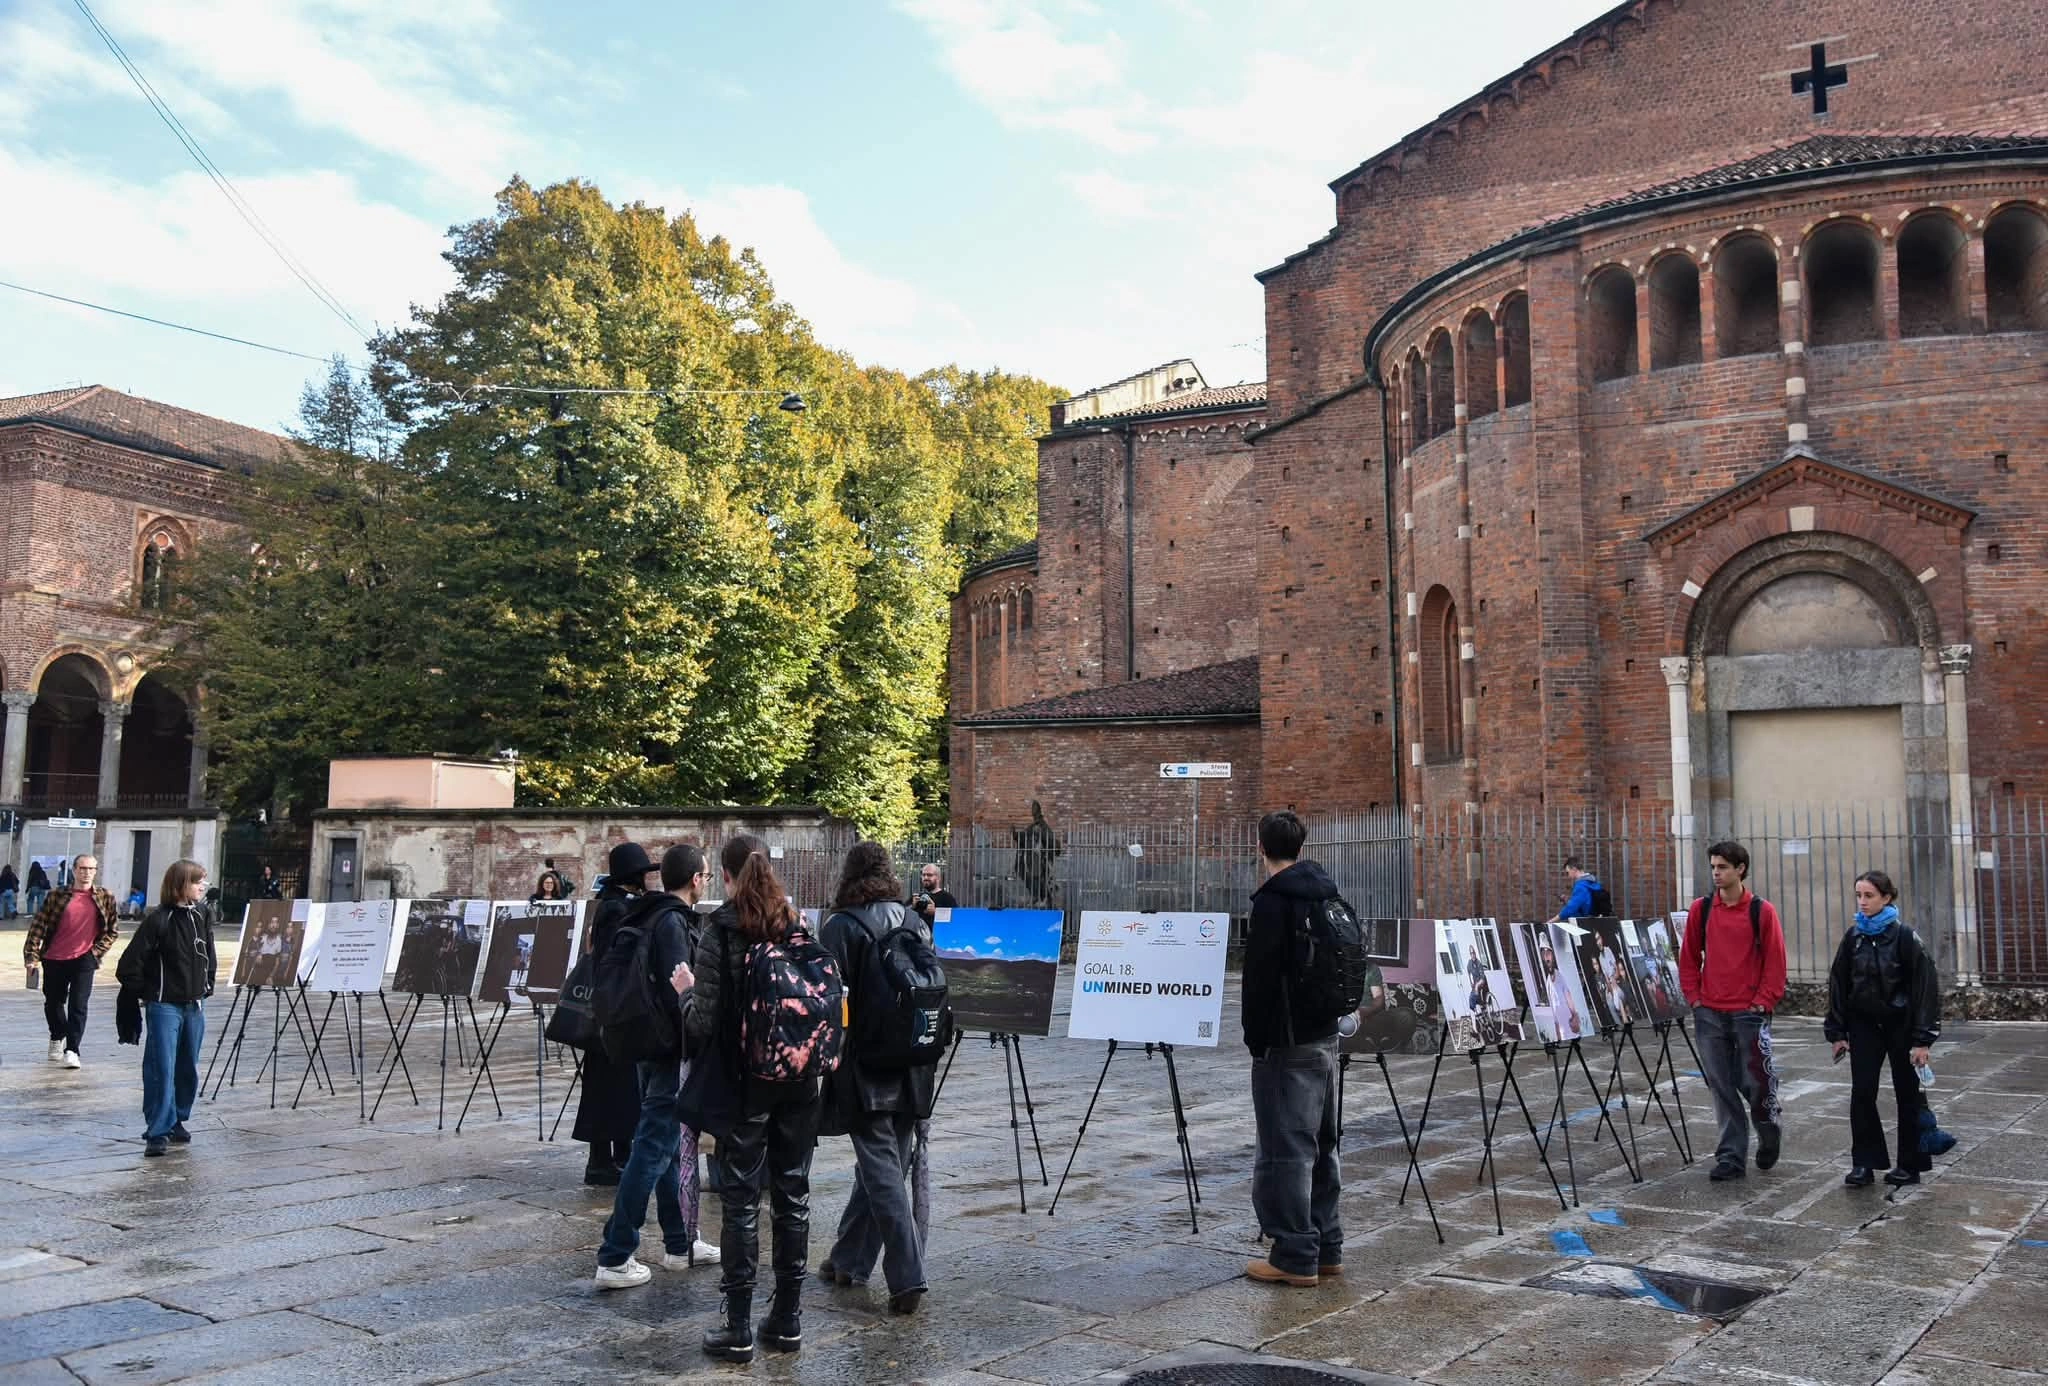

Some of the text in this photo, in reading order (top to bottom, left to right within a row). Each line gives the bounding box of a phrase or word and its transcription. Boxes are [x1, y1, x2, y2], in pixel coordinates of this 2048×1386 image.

[1084, 962, 1135, 976] GOAL 18:
[1083, 981, 1212, 996] UNMINED WORLD
